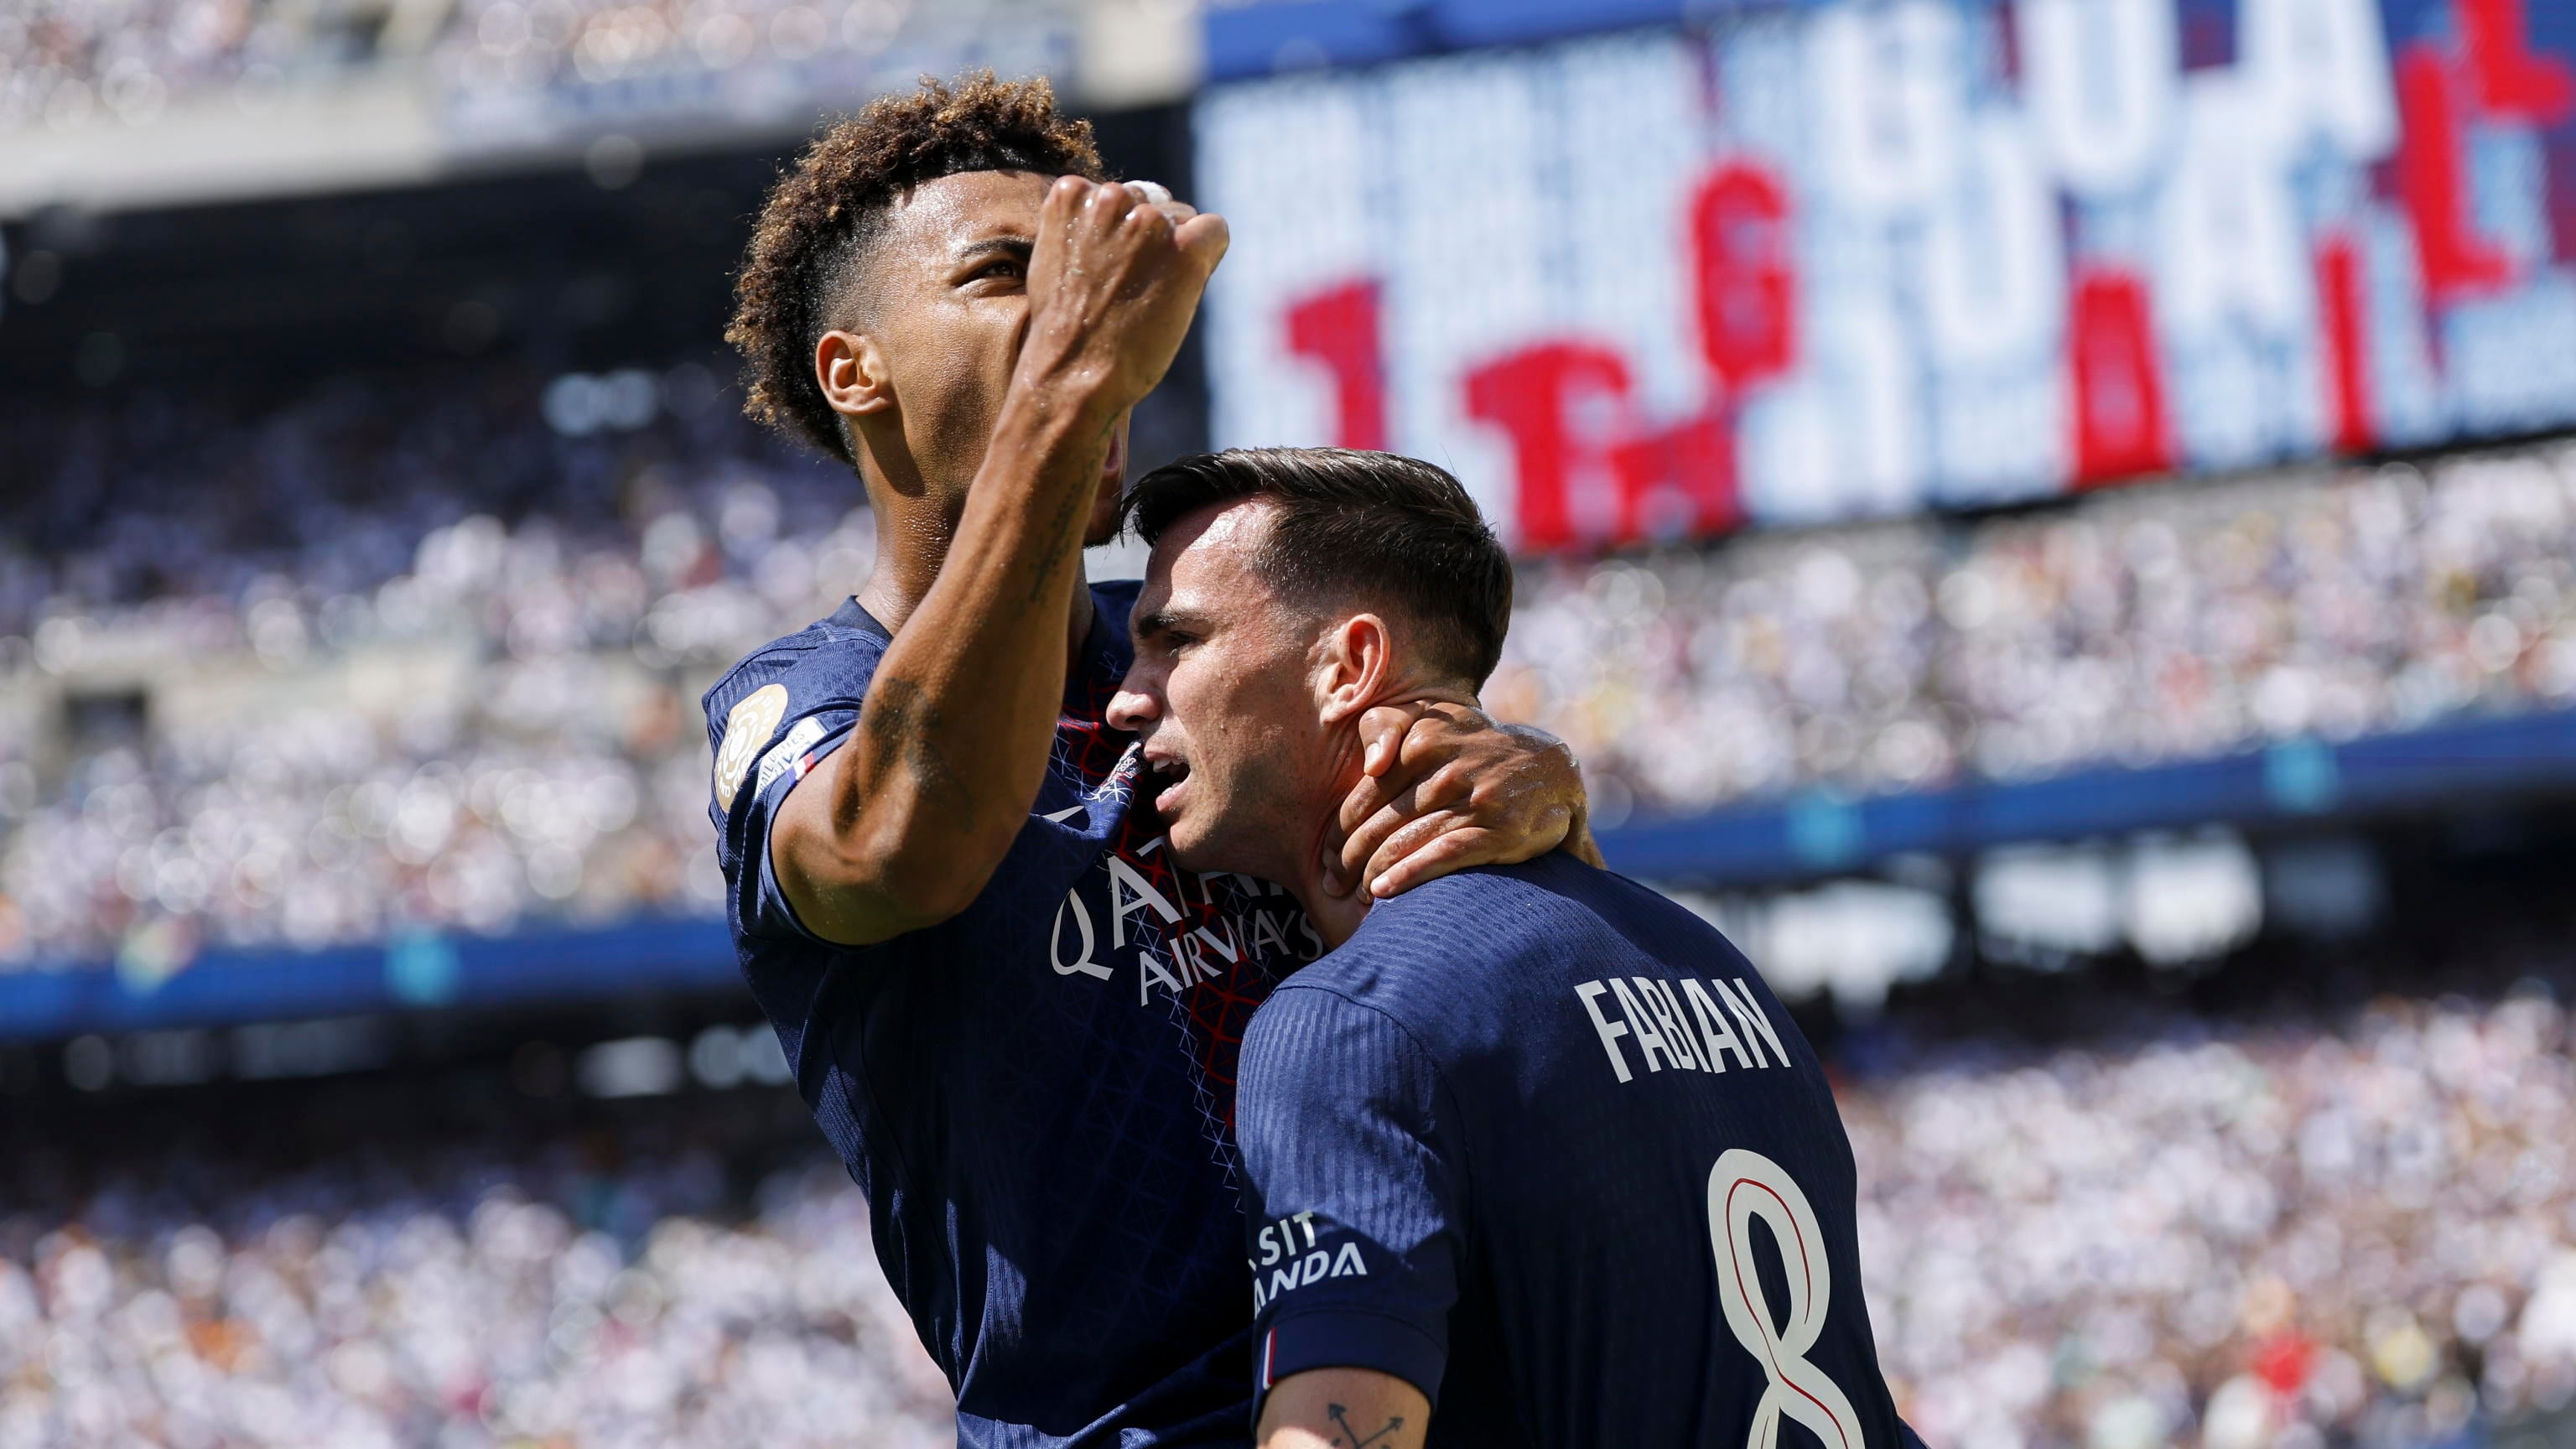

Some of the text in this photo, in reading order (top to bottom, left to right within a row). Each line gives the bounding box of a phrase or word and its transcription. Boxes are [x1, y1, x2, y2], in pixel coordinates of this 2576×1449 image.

[1140, 909, 1323, 1006] AIRWAYS
[1574, 977, 1791, 1083] FABIAN
[1248, 1210, 1315, 1271] SIT
[1708, 1149, 1866, 1449] 8
